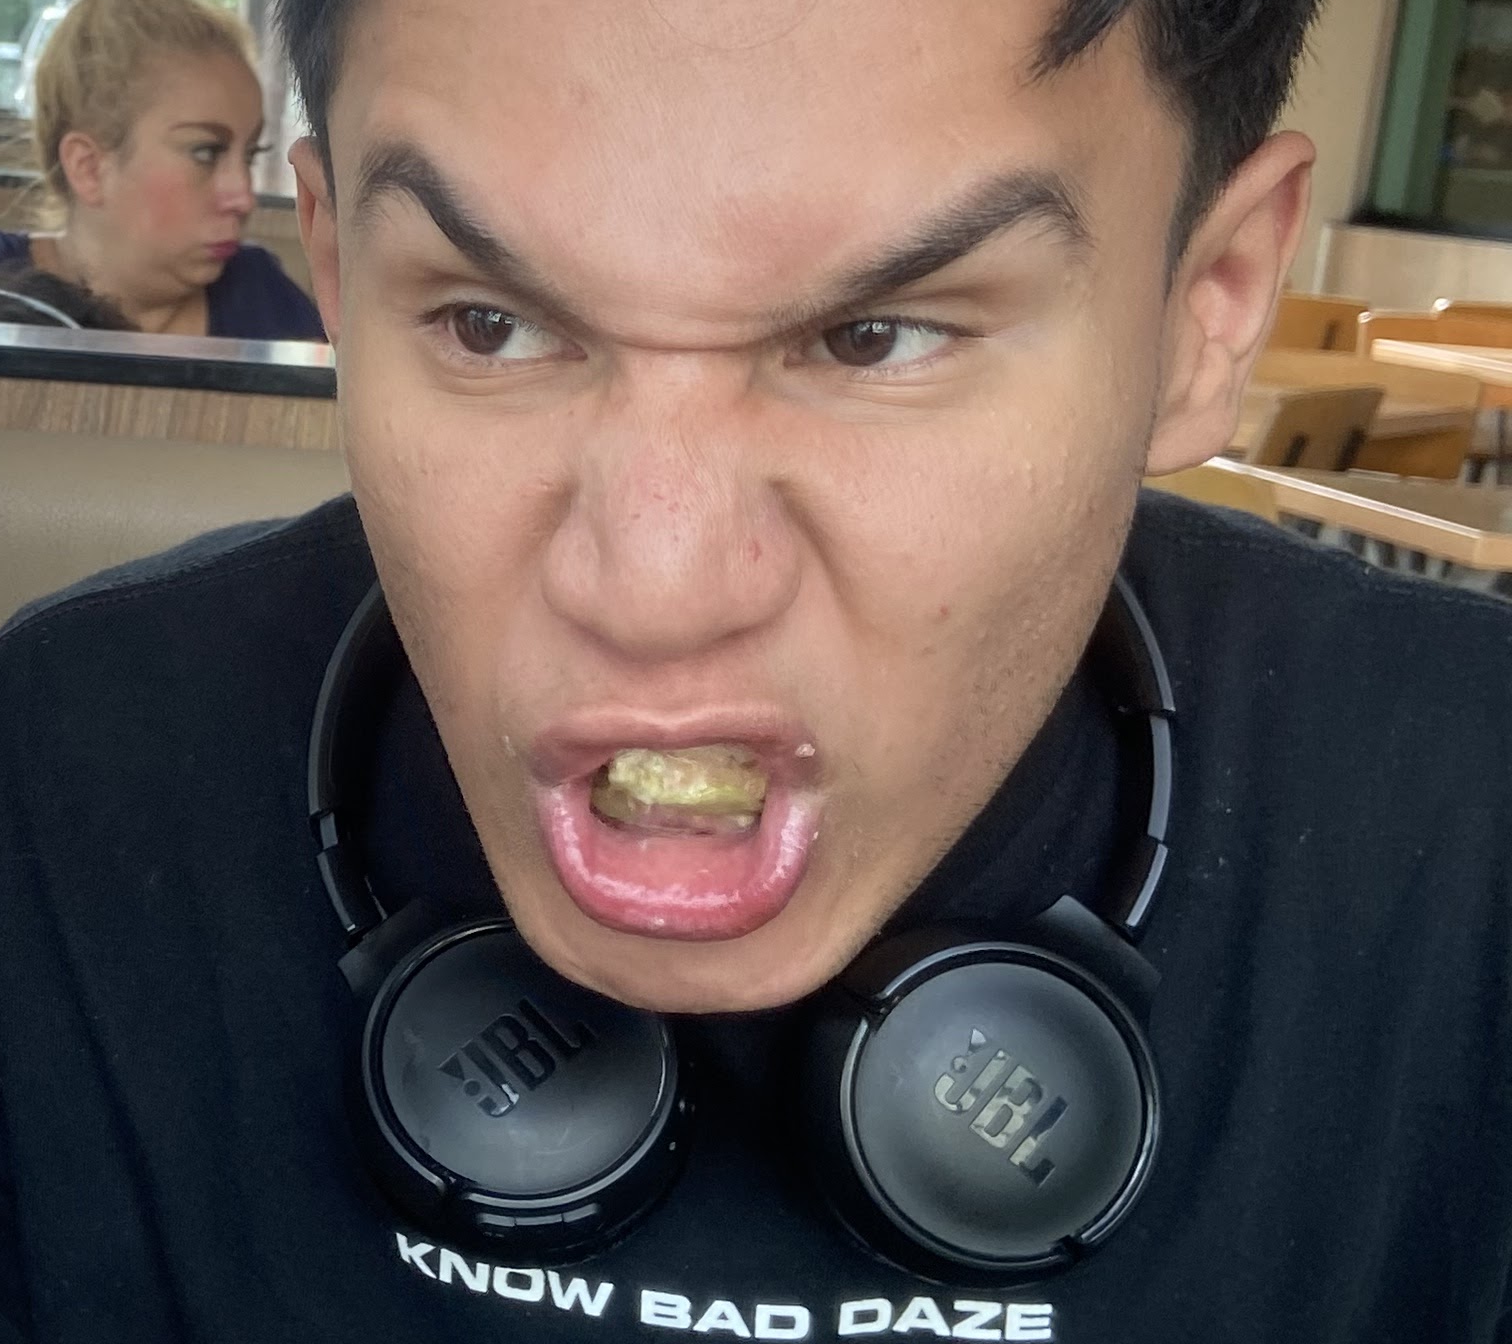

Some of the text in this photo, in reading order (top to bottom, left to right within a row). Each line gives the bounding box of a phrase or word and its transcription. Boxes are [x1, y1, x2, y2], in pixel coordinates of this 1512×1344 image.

[438, 996, 596, 1118] JBL
[934, 1030, 1068, 1188] JBL
[395, 1232, 1055, 1341] KNOW BAD DAZE
